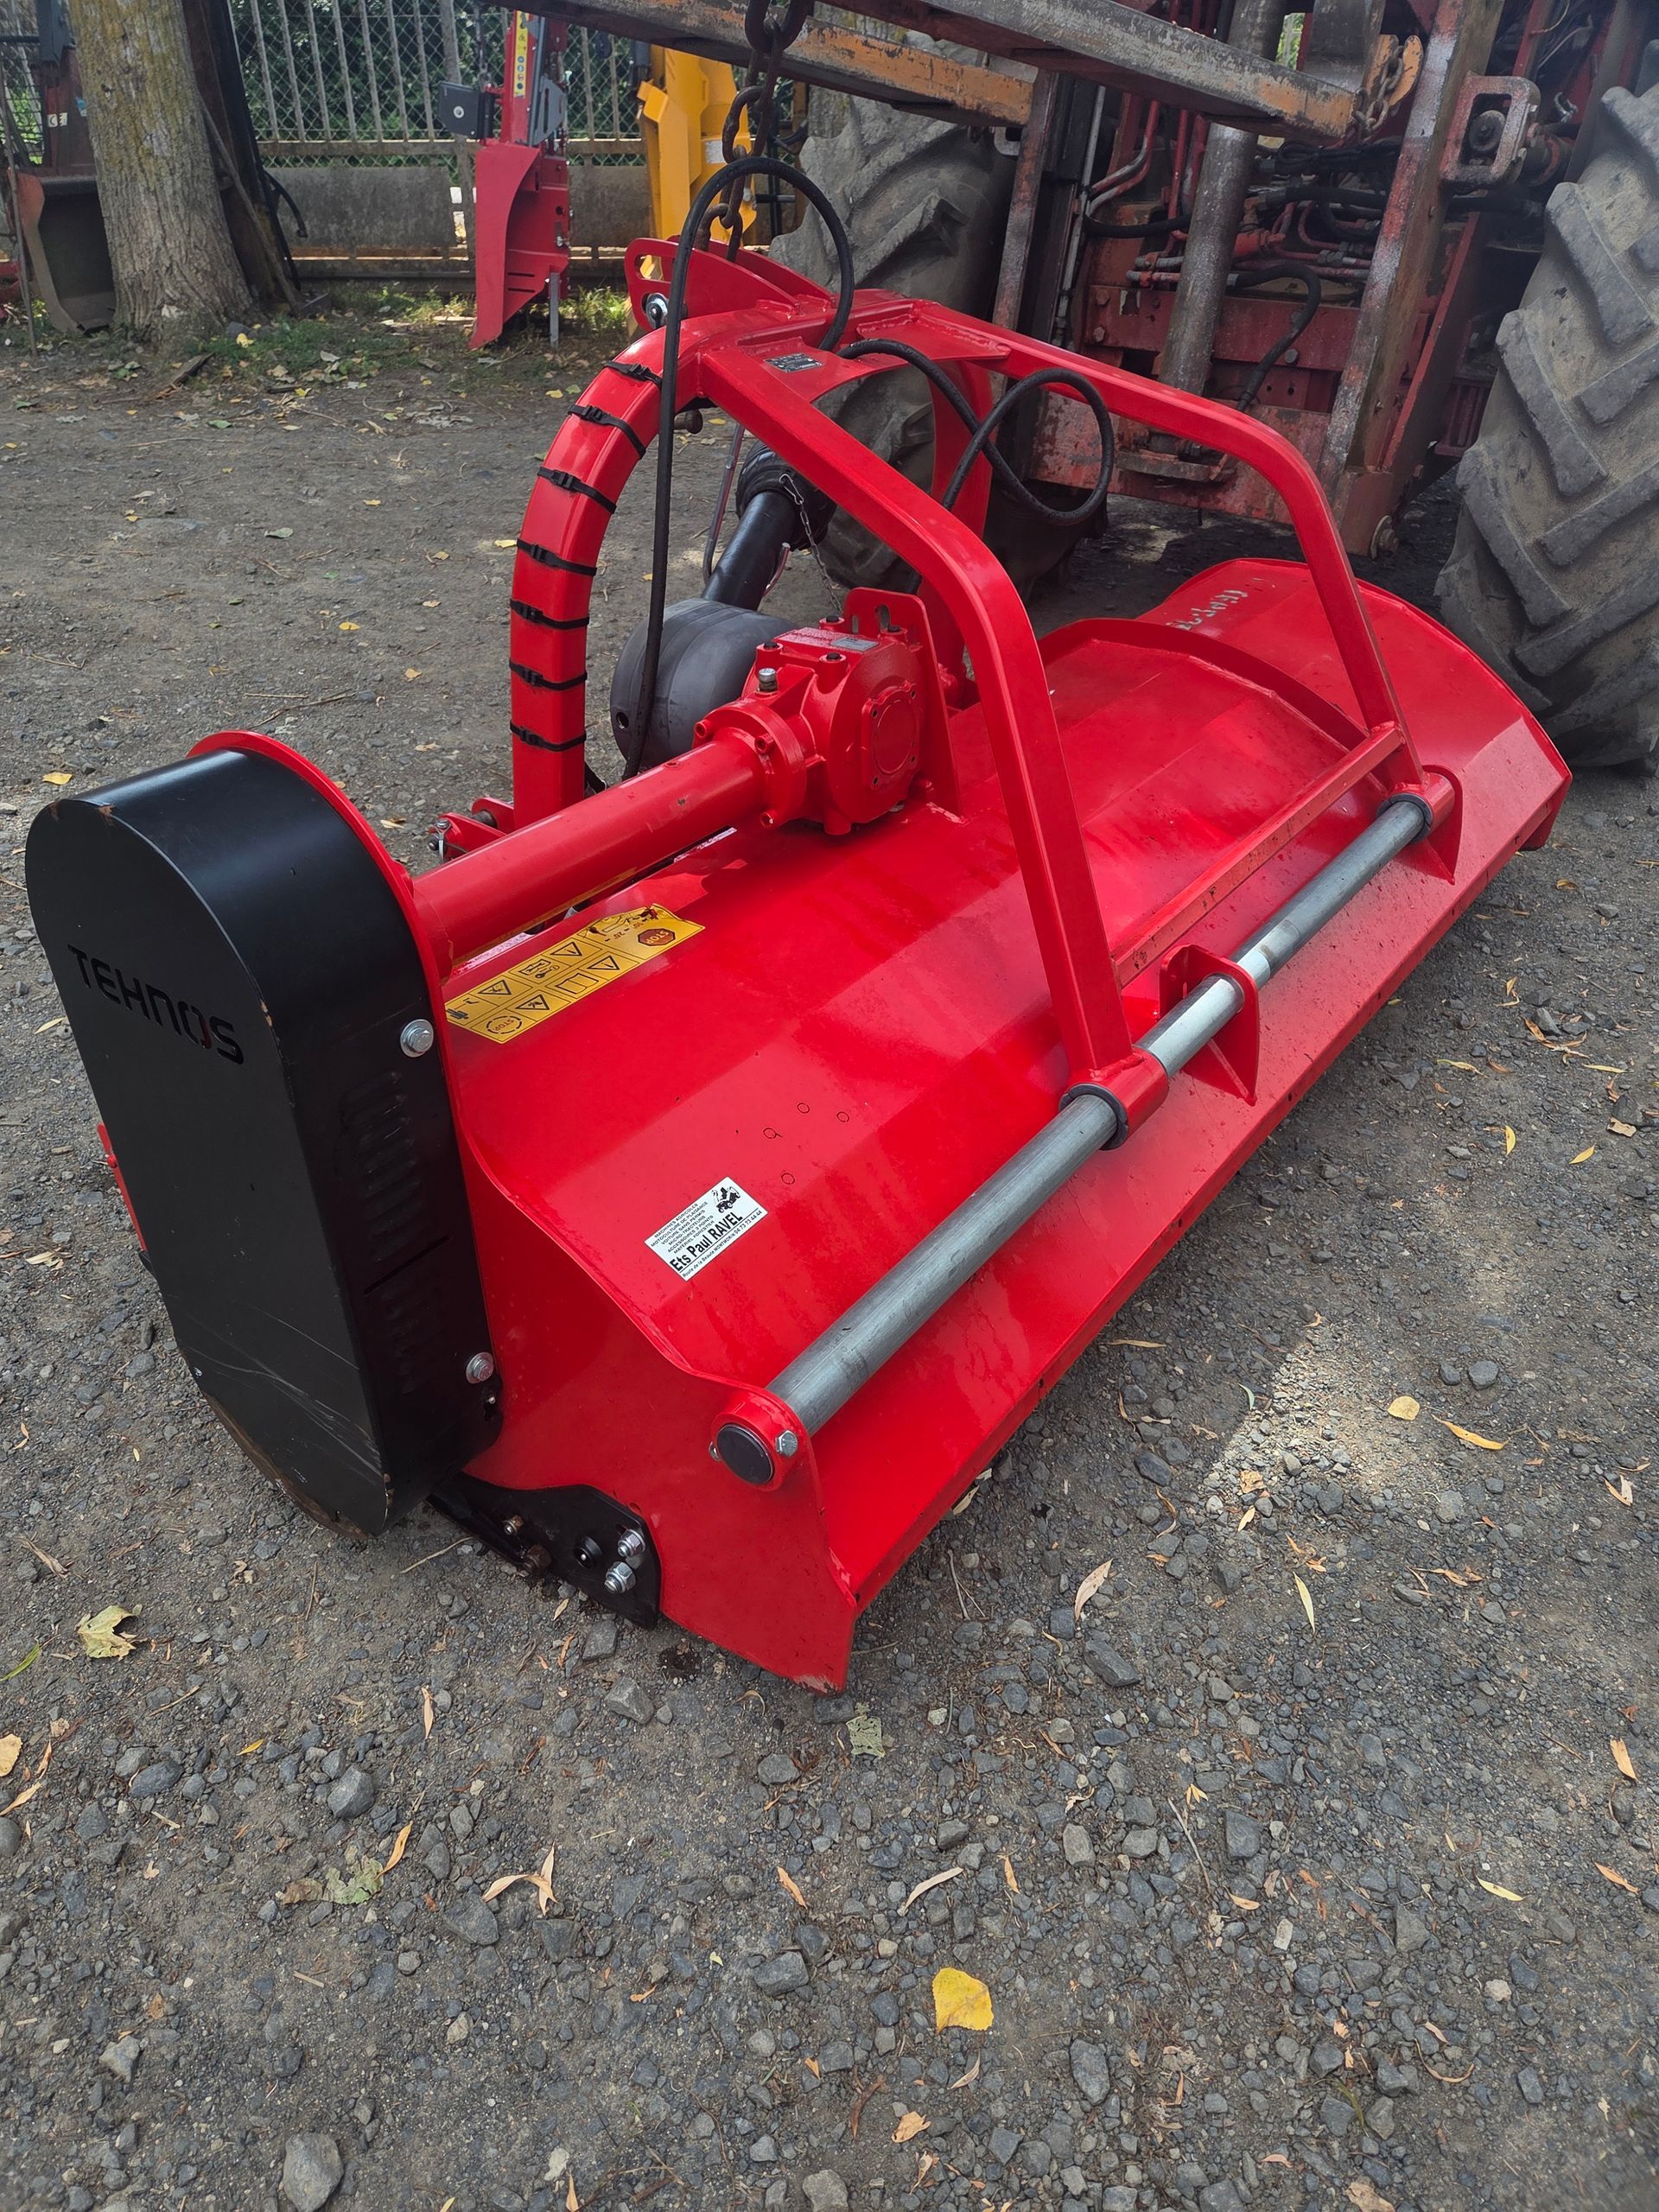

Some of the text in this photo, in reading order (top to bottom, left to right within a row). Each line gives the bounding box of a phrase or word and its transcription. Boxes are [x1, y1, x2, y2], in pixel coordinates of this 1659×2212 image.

[646, 931, 669, 944] STOP
[67, 944, 245, 1065] TEHNOS
[493, 1019, 515, 1031] STOP
[651, 1223, 681, 1247] MOTOCULTURE
[687, 1202, 708, 1218] PLAISANCE
[660, 1209, 705, 1245] VOITURE SANS PERMIS
[676, 1204, 698, 1221] AGRICOLES
[692, 1220, 715, 1238] FORESTIER
[667, 1229, 696, 1252] ACCESSOIRES
[697, 1214, 713, 1227] POINTS
[670, 1211, 742, 1271] Ets Paul RAVEL
